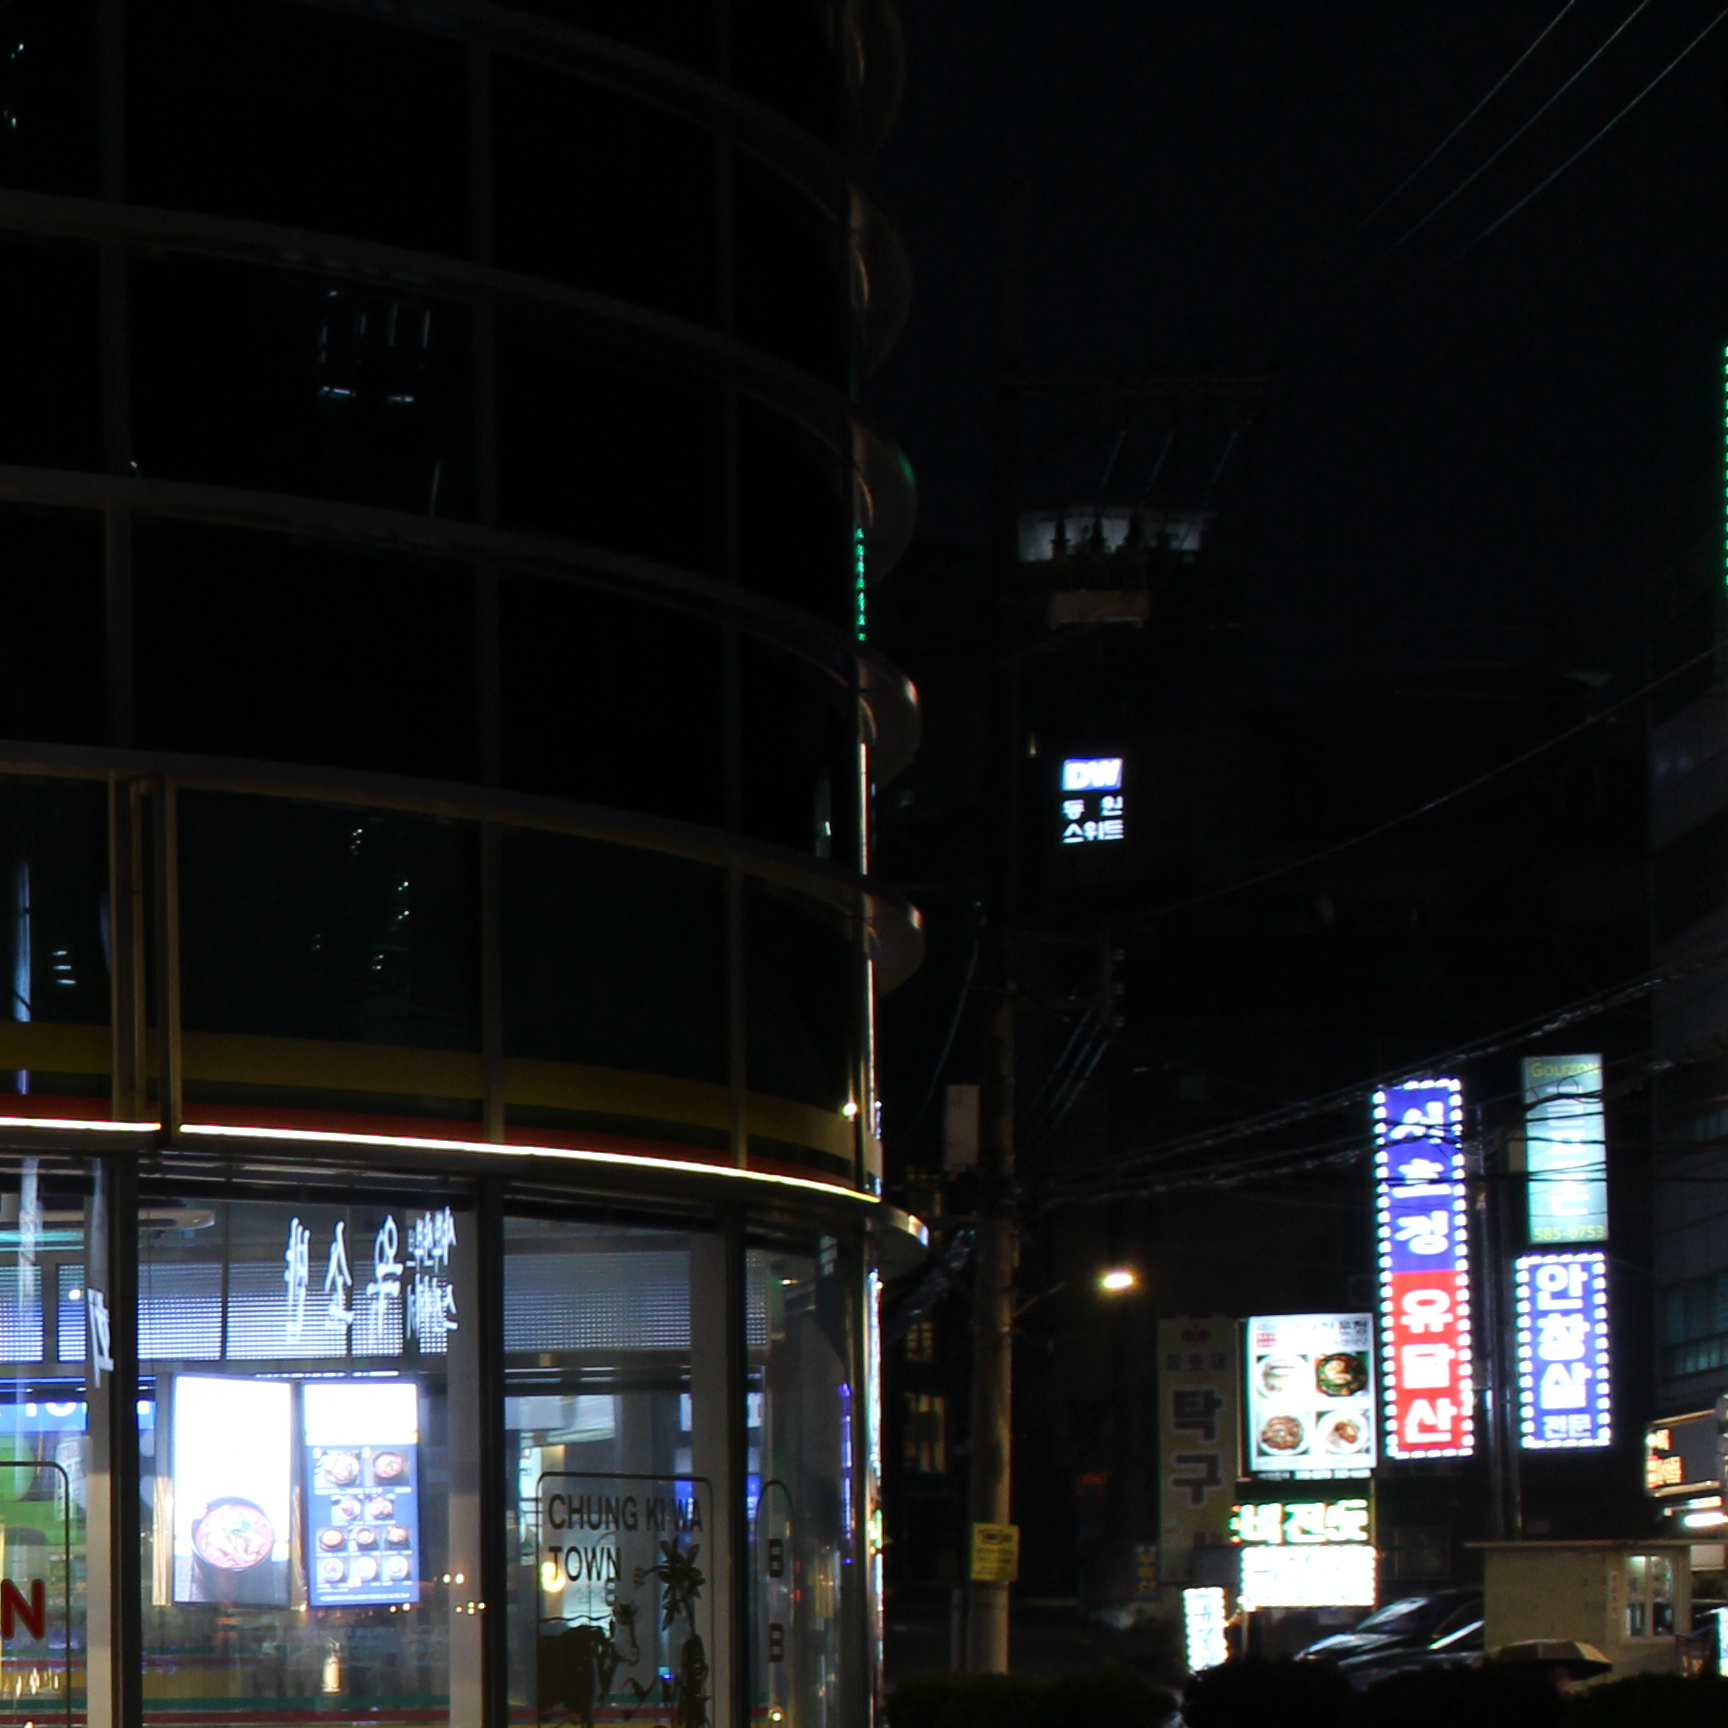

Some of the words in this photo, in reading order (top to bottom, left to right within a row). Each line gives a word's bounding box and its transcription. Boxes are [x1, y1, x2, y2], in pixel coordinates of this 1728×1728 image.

[1065, 759, 1122, 789] DW
[1063, 819, 1124, 844] 스위트
[1536, 1264, 1592, 1410] 안창살
[1401, 1289, 1457, 1443] 유달산
[1543, 1414, 1591, 1439] 전문
[1172, 1388, 1222, 1508] 탁구
[548, 1494, 638, 1531] CHUNG
[646, 1497, 666, 1532] KI
[675, 1498, 704, 1533] WA
[548, 1546, 621, 1582] TOWN
